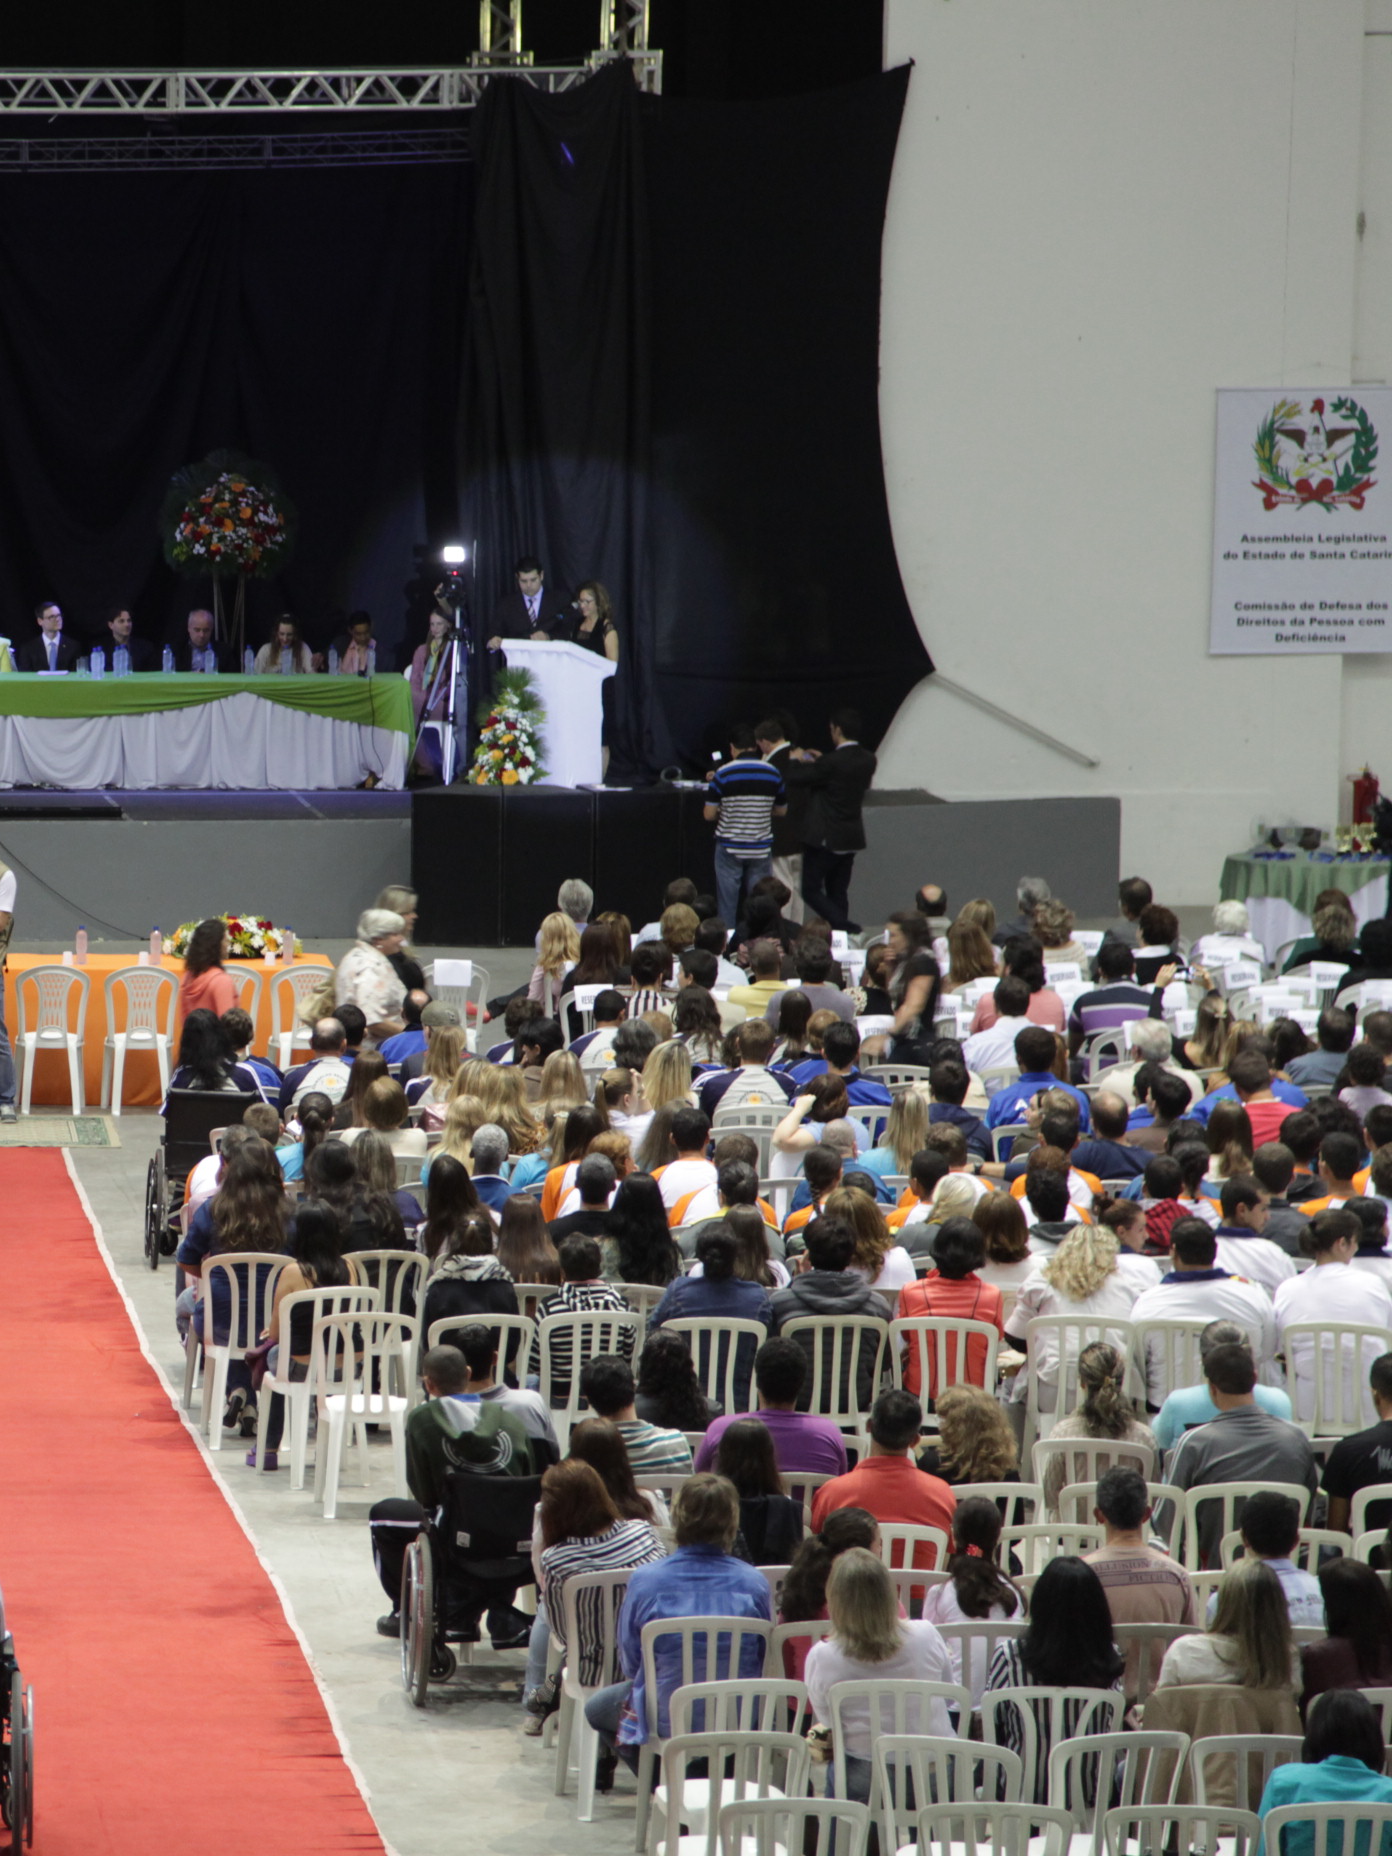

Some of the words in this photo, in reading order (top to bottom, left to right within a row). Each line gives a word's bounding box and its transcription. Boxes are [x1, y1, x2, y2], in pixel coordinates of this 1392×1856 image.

[1240, 533, 1314, 543] Assembleia
[1318, 533, 1387, 545] Legislativa
[1223, 551, 1238, 560] do
[1242, 551, 1286, 560] Estado
[1290, 550, 1305, 560] de
[1309, 550, 1346, 560] Santa
[1234, 601, 1296, 611] Comissão
[1300, 601, 1315, 611] de
[1319, 601, 1362, 611] Defesa
[1366, 601, 1388, 610] dos
[1236, 617, 1286, 627] Direitos
[1290, 617, 1305, 626] da
[1309, 617, 1354, 626] Pessoa
[1358, 618, 1385, 626] com
